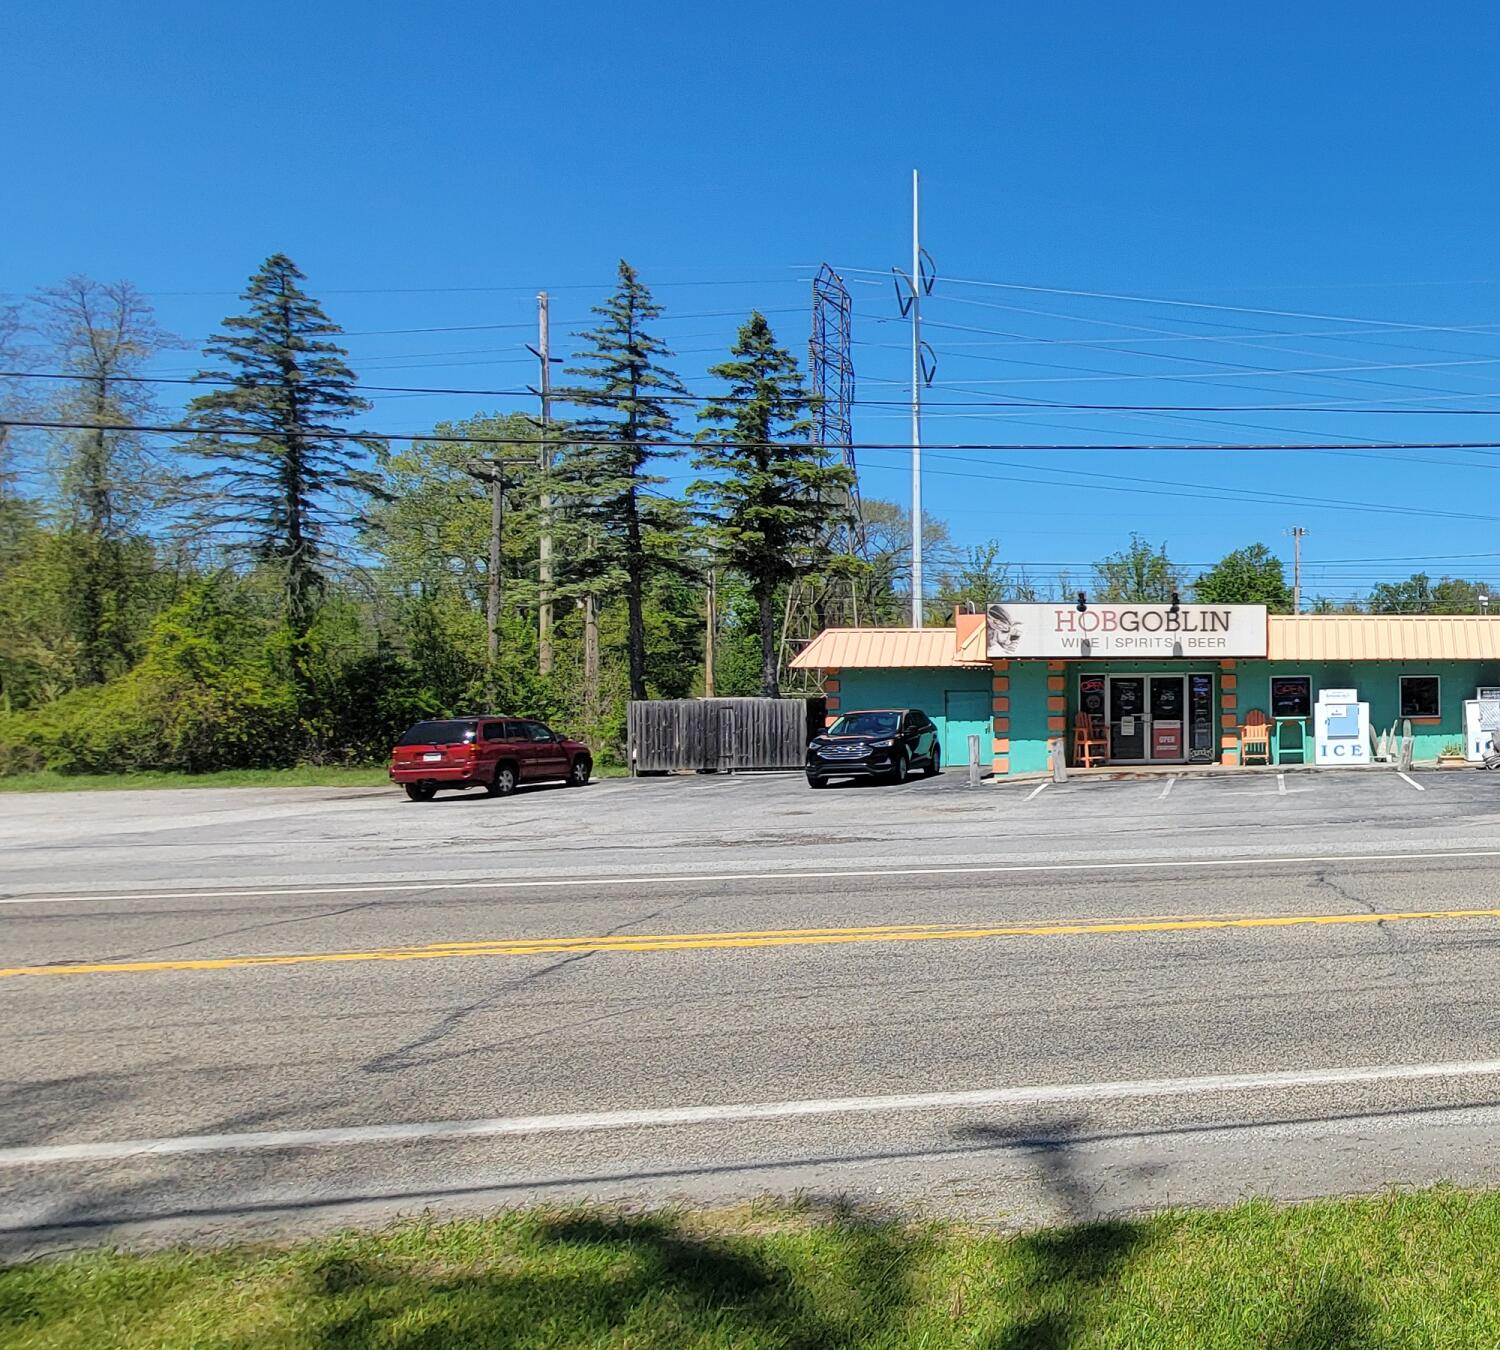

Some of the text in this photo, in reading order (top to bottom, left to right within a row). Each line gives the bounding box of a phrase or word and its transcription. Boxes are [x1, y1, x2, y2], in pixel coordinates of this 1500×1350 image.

[1054, 610, 1232, 632] HOBGOBLIN
[1061, 637, 1226, 648] WINE SPIRITS BEER
[1321, 745, 1363, 757] ICE
